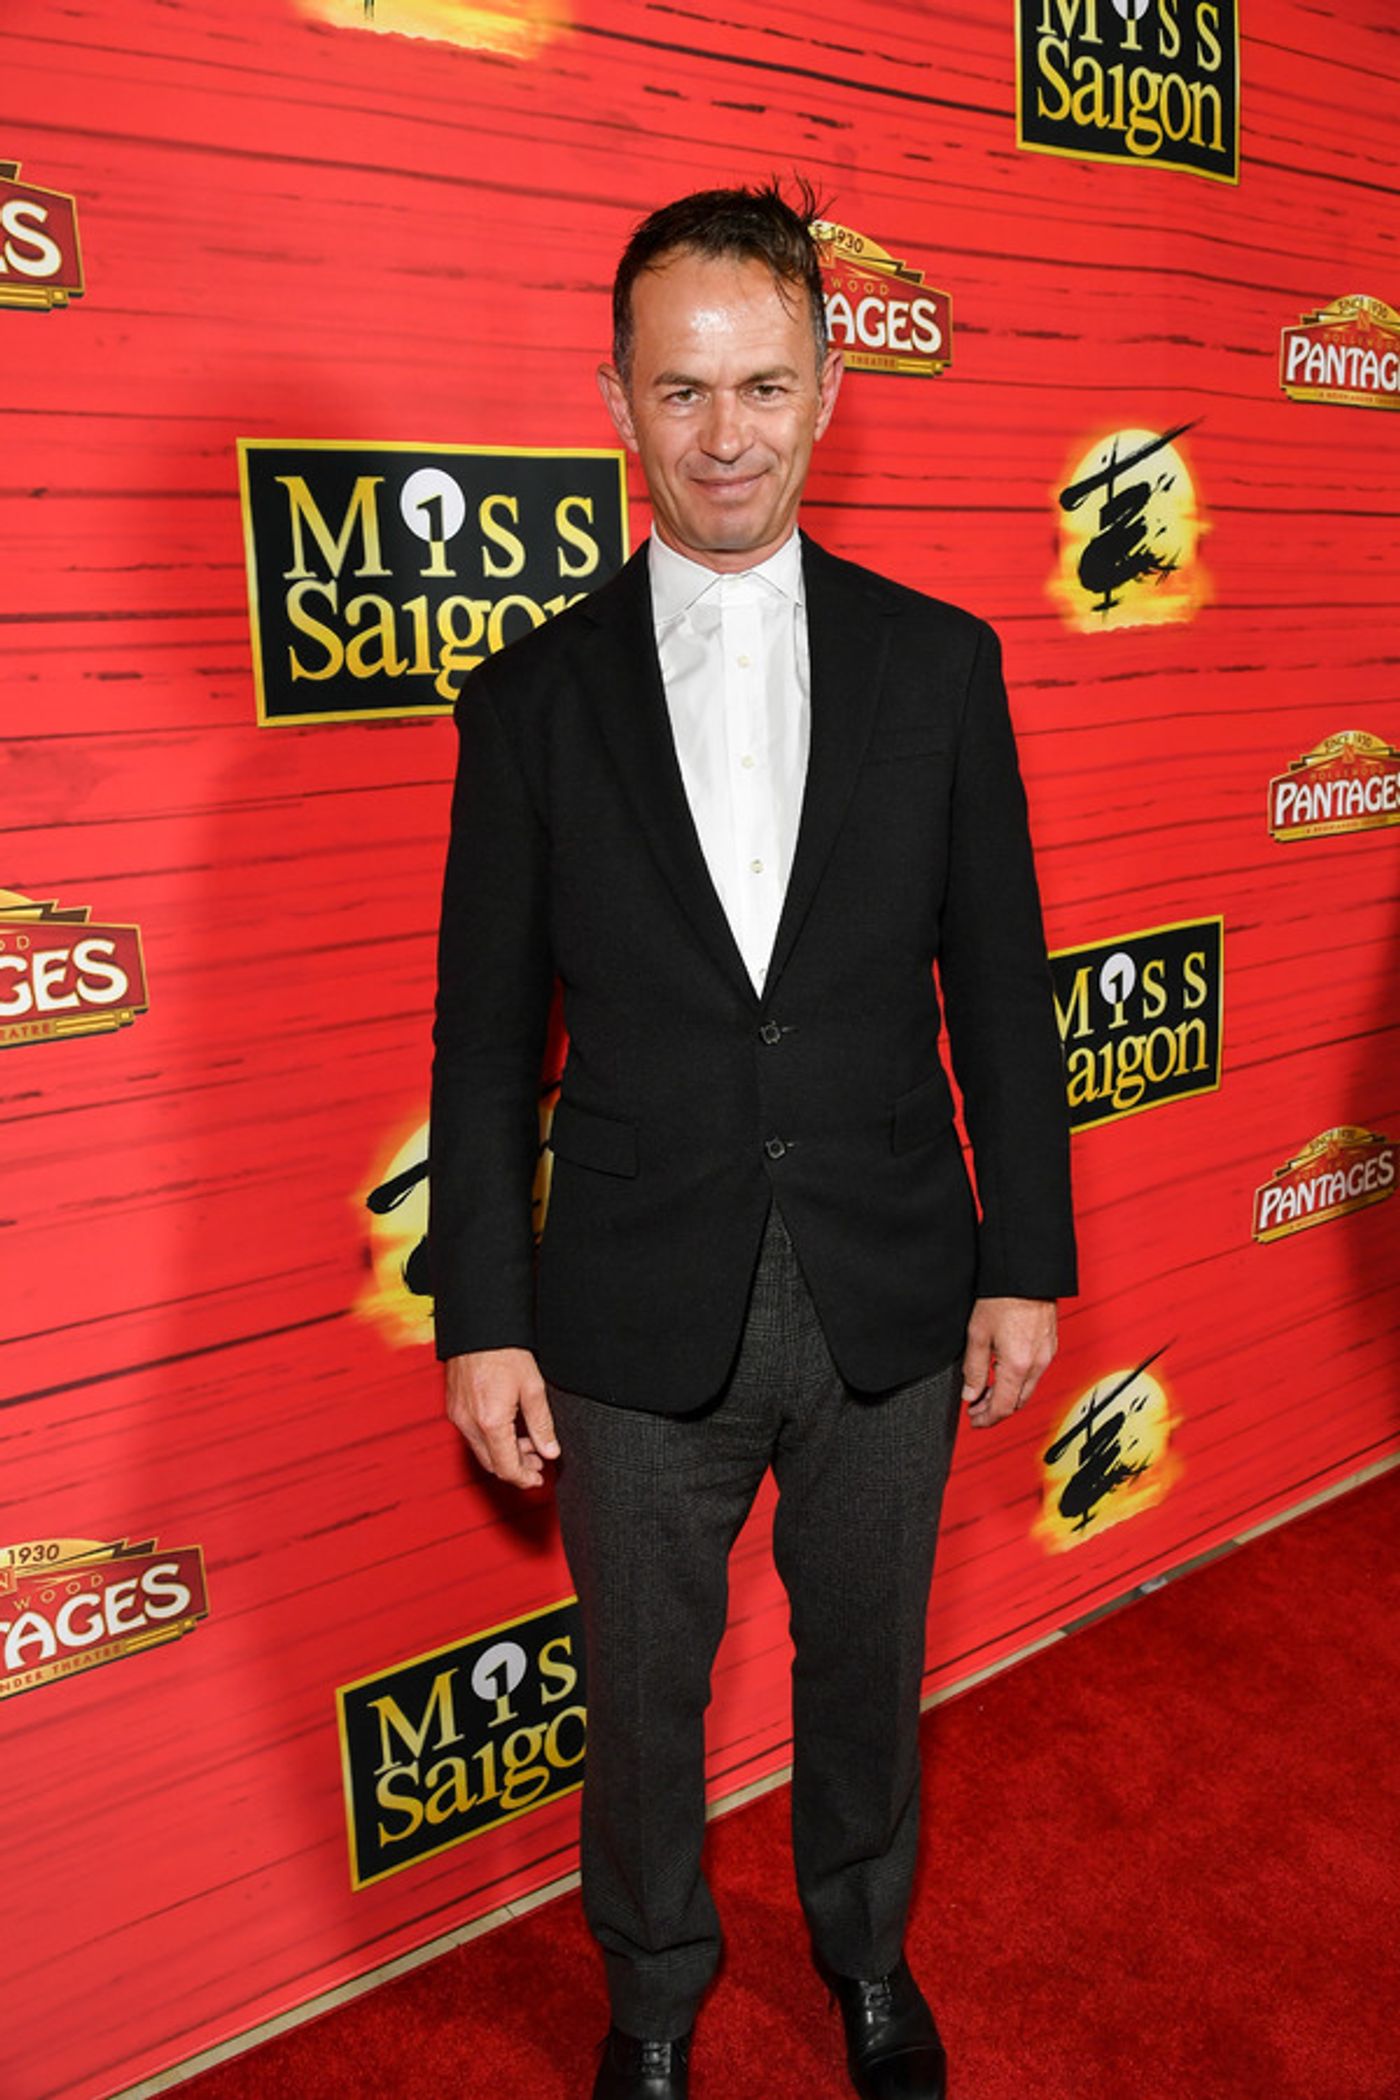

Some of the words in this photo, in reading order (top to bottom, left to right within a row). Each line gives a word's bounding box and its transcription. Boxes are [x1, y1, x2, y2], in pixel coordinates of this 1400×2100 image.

[1037, 36, 1226, 156] Saigon
[823, 292, 942, 353] AGES
[1286, 336, 1400, 391] PANTAG
[274, 470, 600, 580] Miss
[1275, 772, 1400, 826] PANTAGE
[1064, 1017, 1209, 1110] aigon
[1259, 1150, 1395, 1229] PANTAGES
[8, 1544, 60, 1565] 1930
[52, 1644, 122, 1675] THEATRE
[367, 1635, 577, 1775] Mis
[376, 1706, 587, 1848] Saigo
